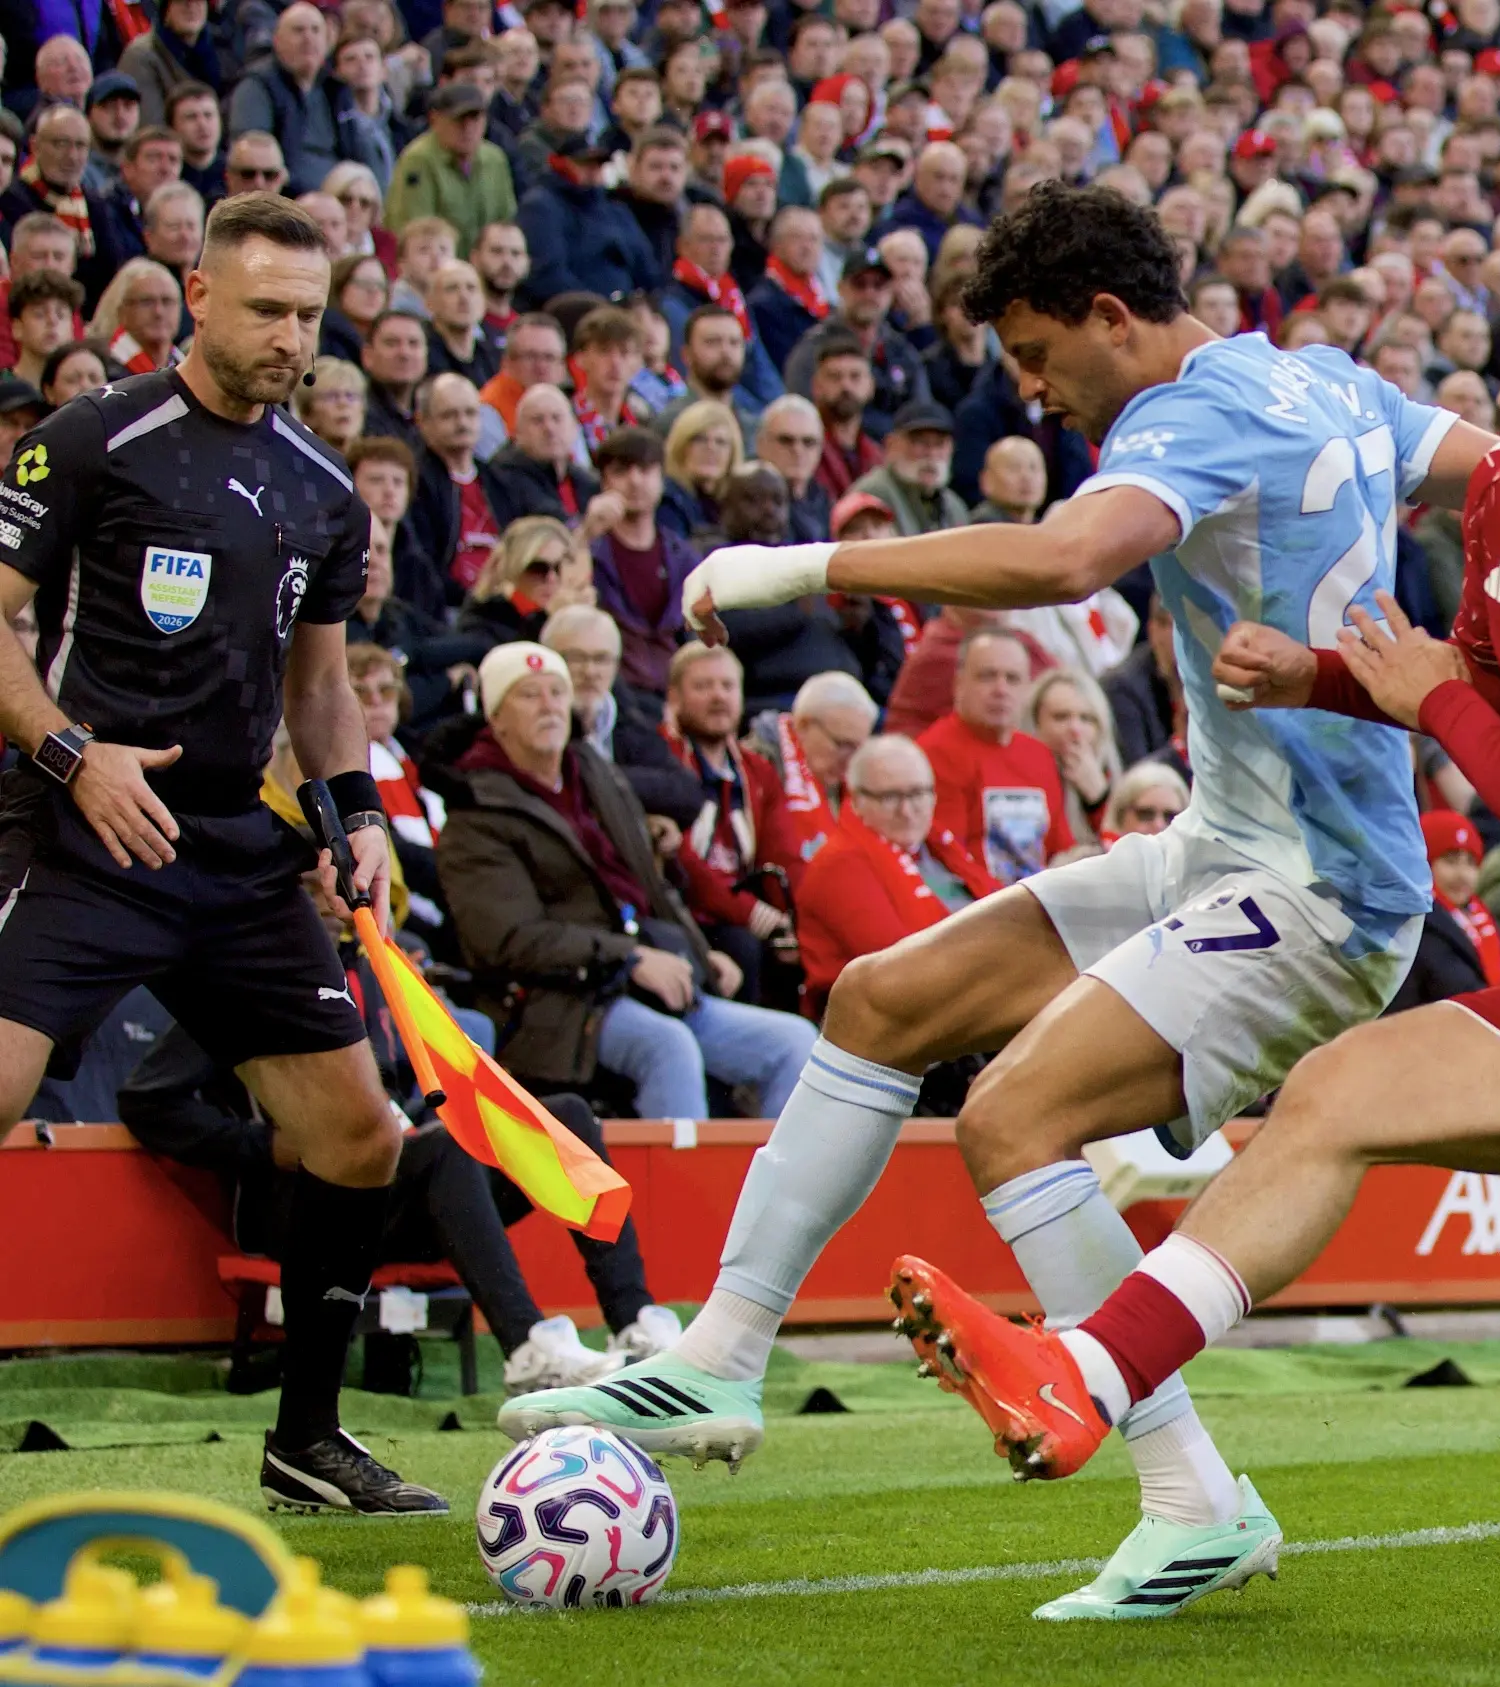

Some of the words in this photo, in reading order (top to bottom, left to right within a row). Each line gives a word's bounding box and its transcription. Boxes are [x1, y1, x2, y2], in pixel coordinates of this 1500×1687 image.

[9, 507, 42, 531] Supplies
[151, 553, 204, 579] FIFA
[148, 583, 202, 597] ASSISTANT
[151, 593, 196, 607] REFEREE
[157, 615, 183, 628] 2026
